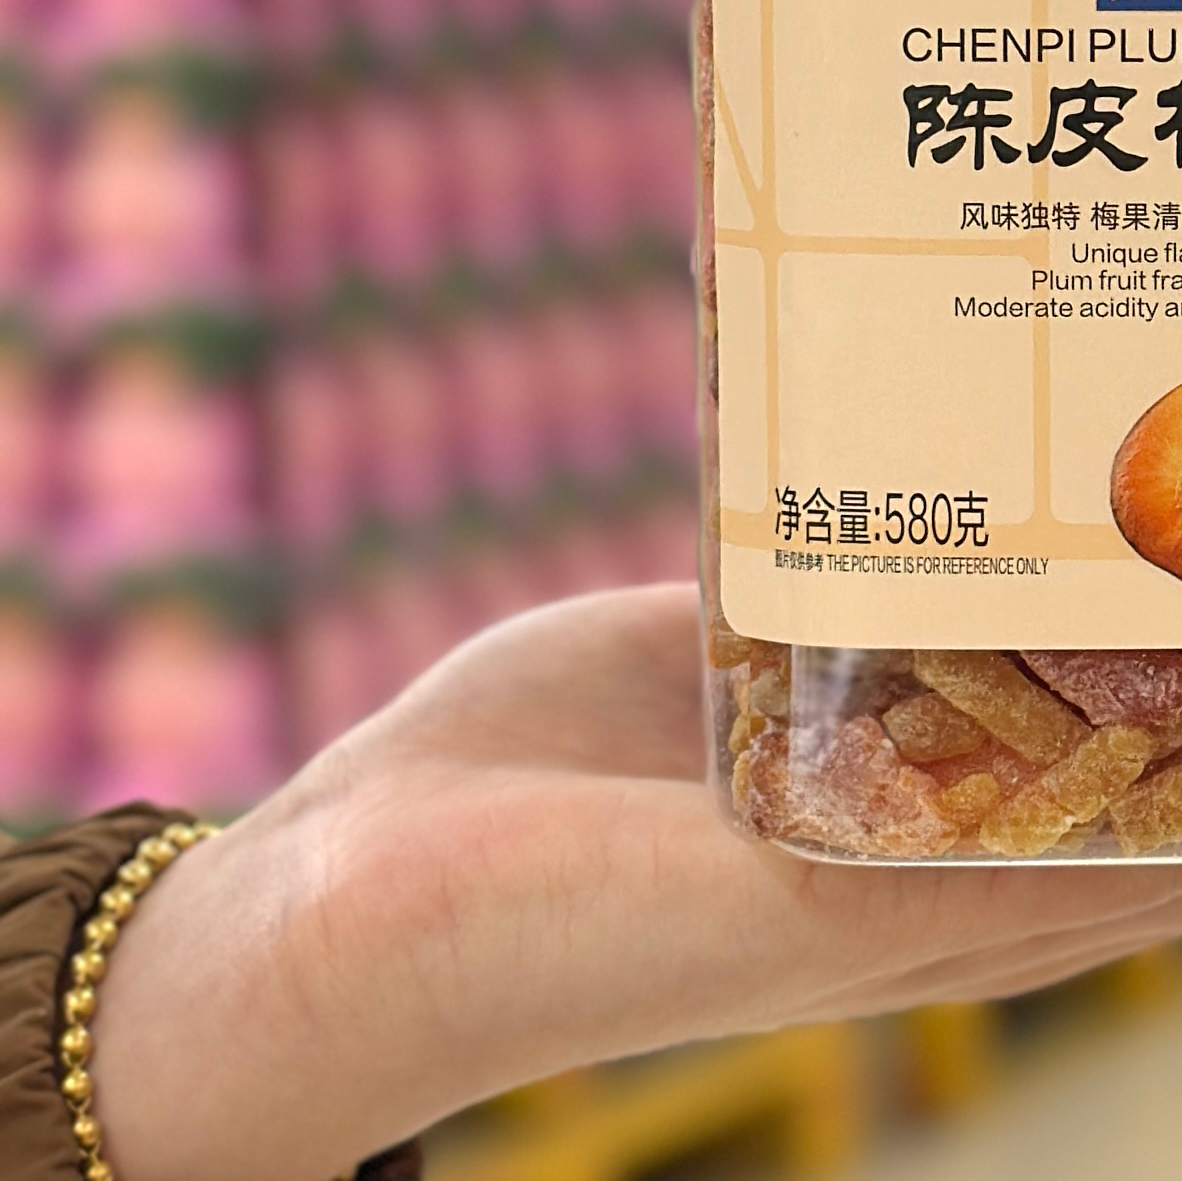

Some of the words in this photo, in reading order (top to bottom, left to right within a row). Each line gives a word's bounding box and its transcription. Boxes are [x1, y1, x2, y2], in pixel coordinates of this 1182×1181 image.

[902, 27, 1075, 63] CHENPI
[960, 201, 1081, 231] 风味独特
[1071, 242, 1159, 267] Unique
[1031, 269, 1093, 291] Plum
[1098, 268, 1147, 291] fruit
[954, 296, 1074, 319] Moderate
[1079, 296, 1159, 323] acidity
[775, 485, 990, 548] 净含量:580克
[827, 554, 850, 573] THE
[851, 554, 902, 574] PICTURE
[903, 556, 915, 574] IS
[916, 556, 941, 575] FOR
[942, 556, 1015, 576] REFERENCE
[1016, 557, 1049, 575] ONLY
